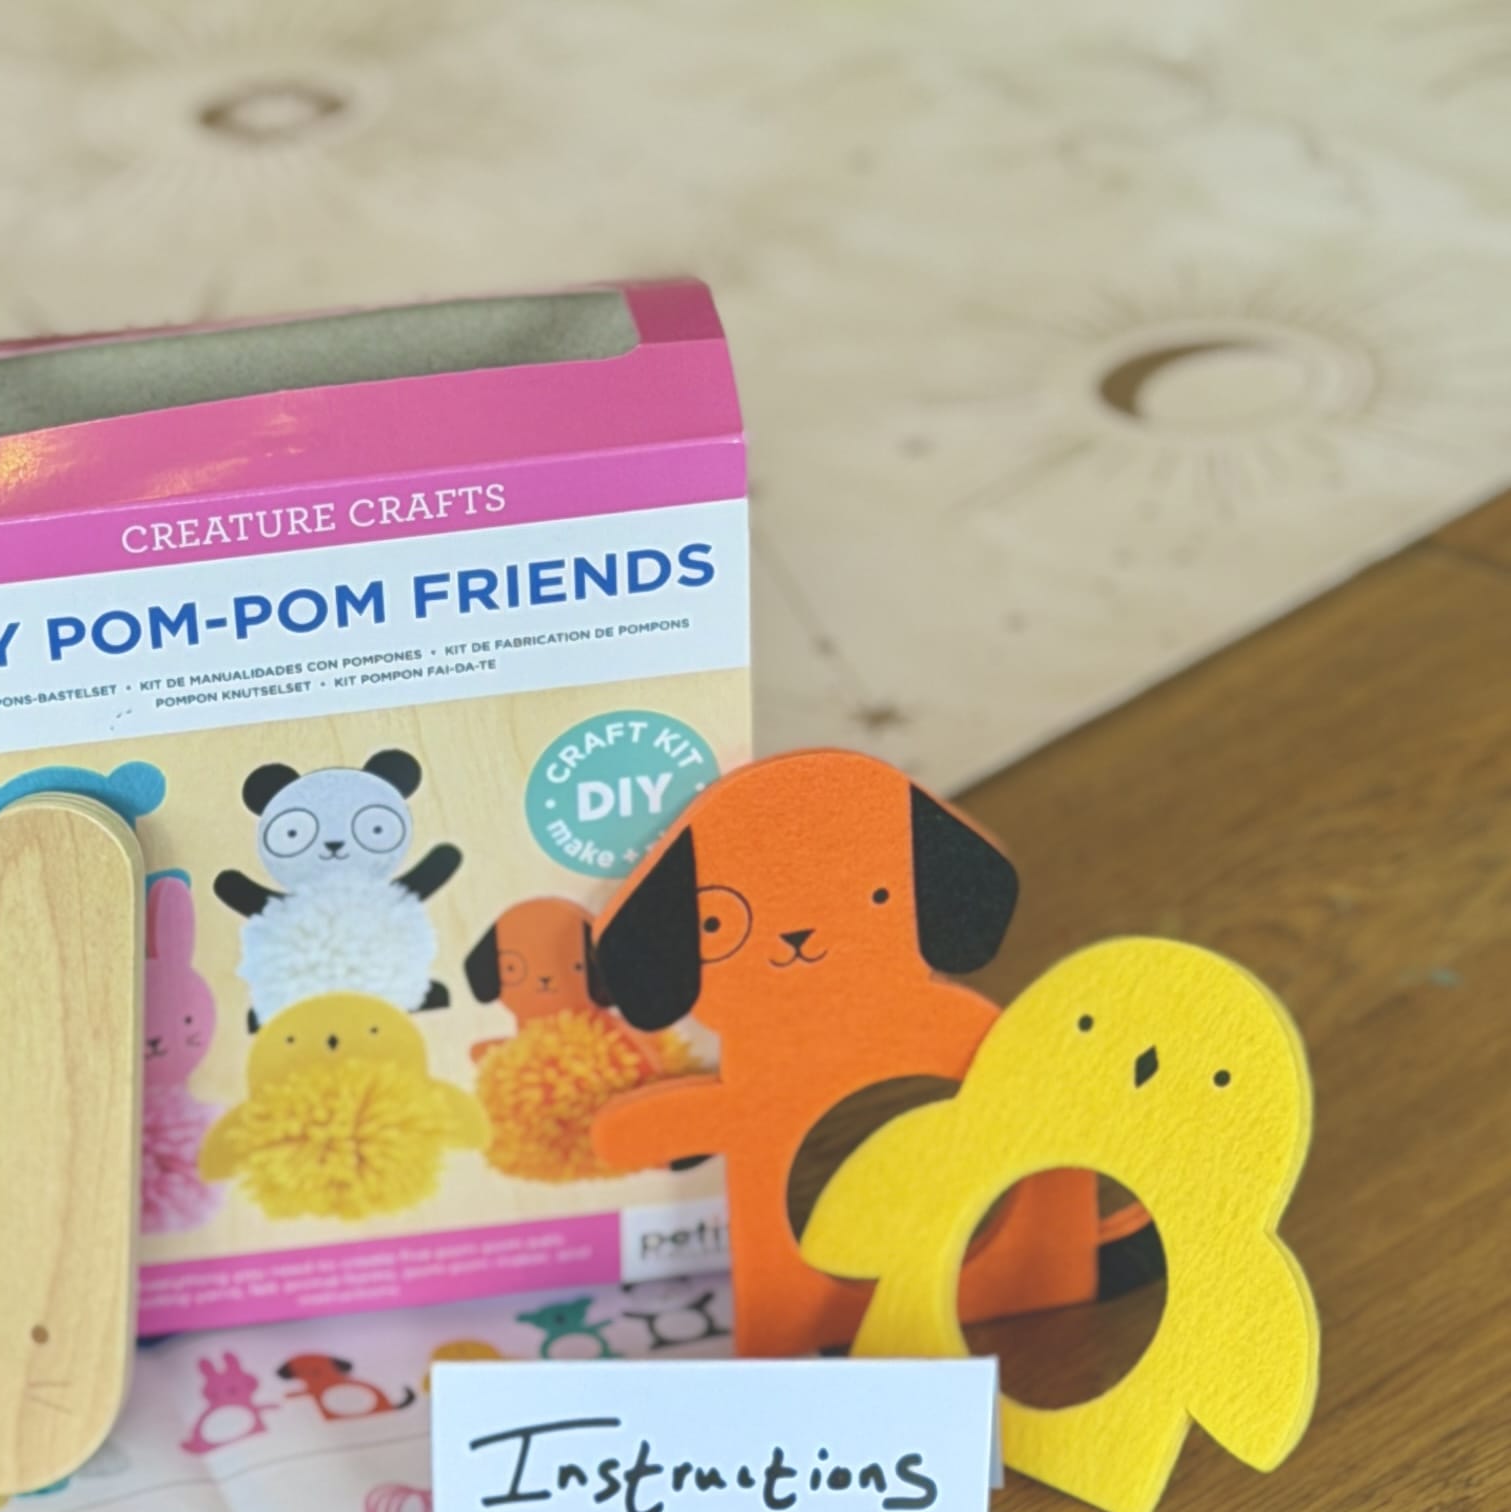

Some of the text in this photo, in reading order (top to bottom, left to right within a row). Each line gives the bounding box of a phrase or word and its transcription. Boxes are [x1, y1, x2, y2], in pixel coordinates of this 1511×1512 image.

[121, 483, 506, 554] CREATURE CRAFTS
[46, 580, 386, 661] POM-POM
[413, 542, 716, 619] FRIENDS
[444, 617, 691, 657] KIT DE FABRICATION DE POMPONS
[139, 648, 423, 693] KIT DE MANUALIDADES CON POMPONES
[155, 680, 312, 708] POMPON KNUTSELSET
[334, 658, 498, 688] KIT POMPON FAI-DA-TE
[546, 720, 705, 785] CRAFT KIT
[576, 772, 674, 823] DIY
[546, 818, 616, 869] make
[640, 1214, 726, 1261] peti
